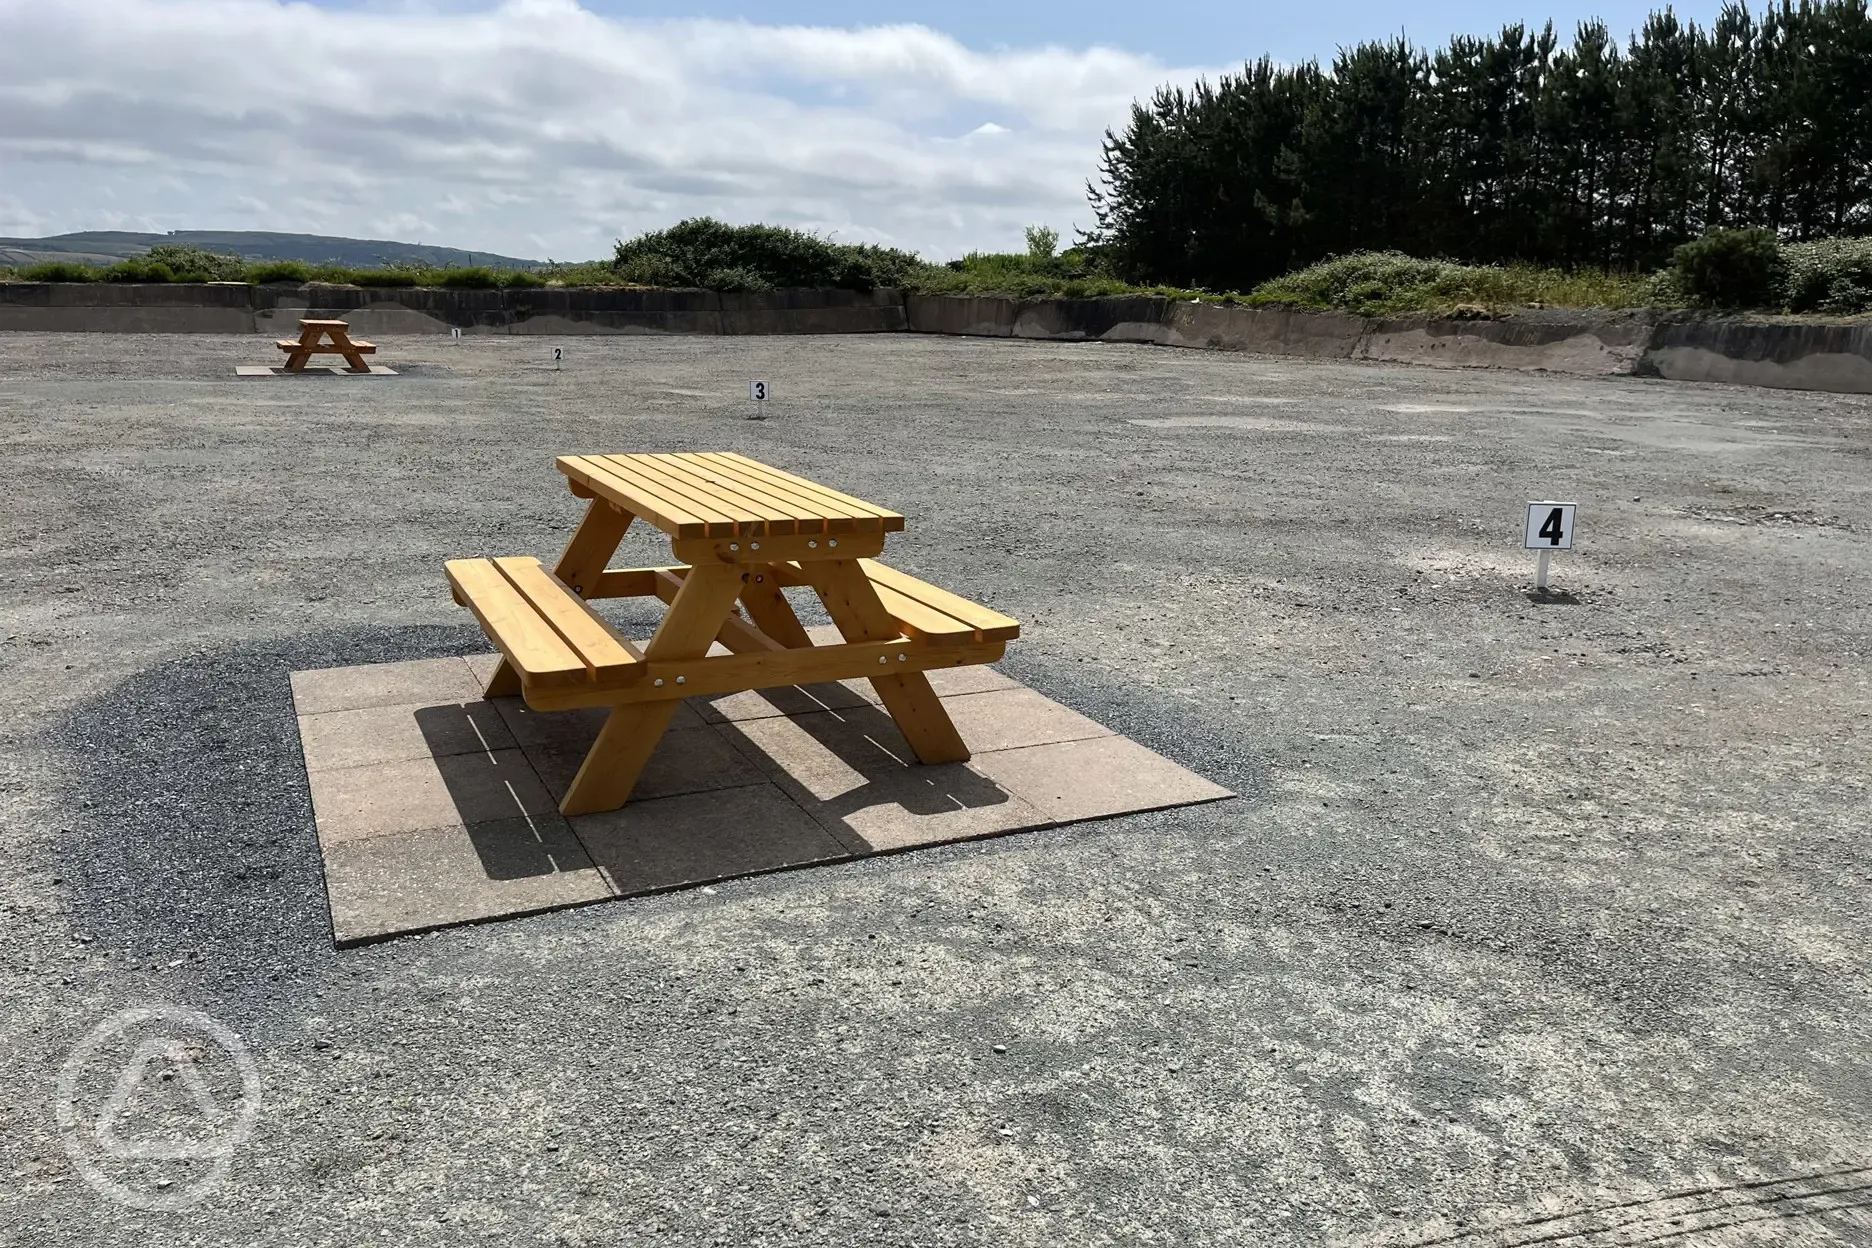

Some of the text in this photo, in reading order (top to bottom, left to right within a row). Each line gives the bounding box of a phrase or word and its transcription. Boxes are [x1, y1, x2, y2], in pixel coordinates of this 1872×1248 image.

[555, 348, 561, 360] 2
[756, 382, 765, 400] 3
[1538, 508, 1563, 546] 4
